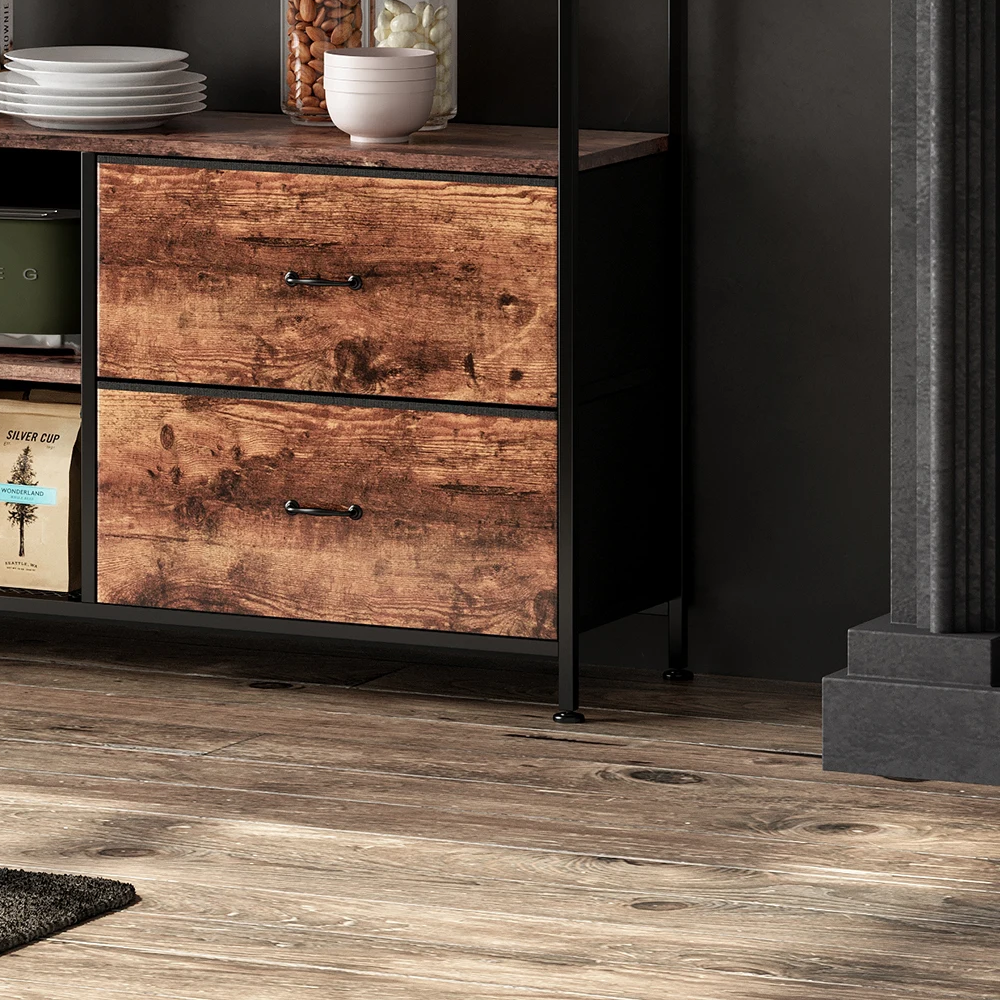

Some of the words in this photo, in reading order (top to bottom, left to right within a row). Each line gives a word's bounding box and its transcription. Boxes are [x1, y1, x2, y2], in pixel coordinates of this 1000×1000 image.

[6, 430, 39, 442] SILVER
[40, 433, 61, 444] CUP
[1, 487, 45, 496] WONDERLAND
